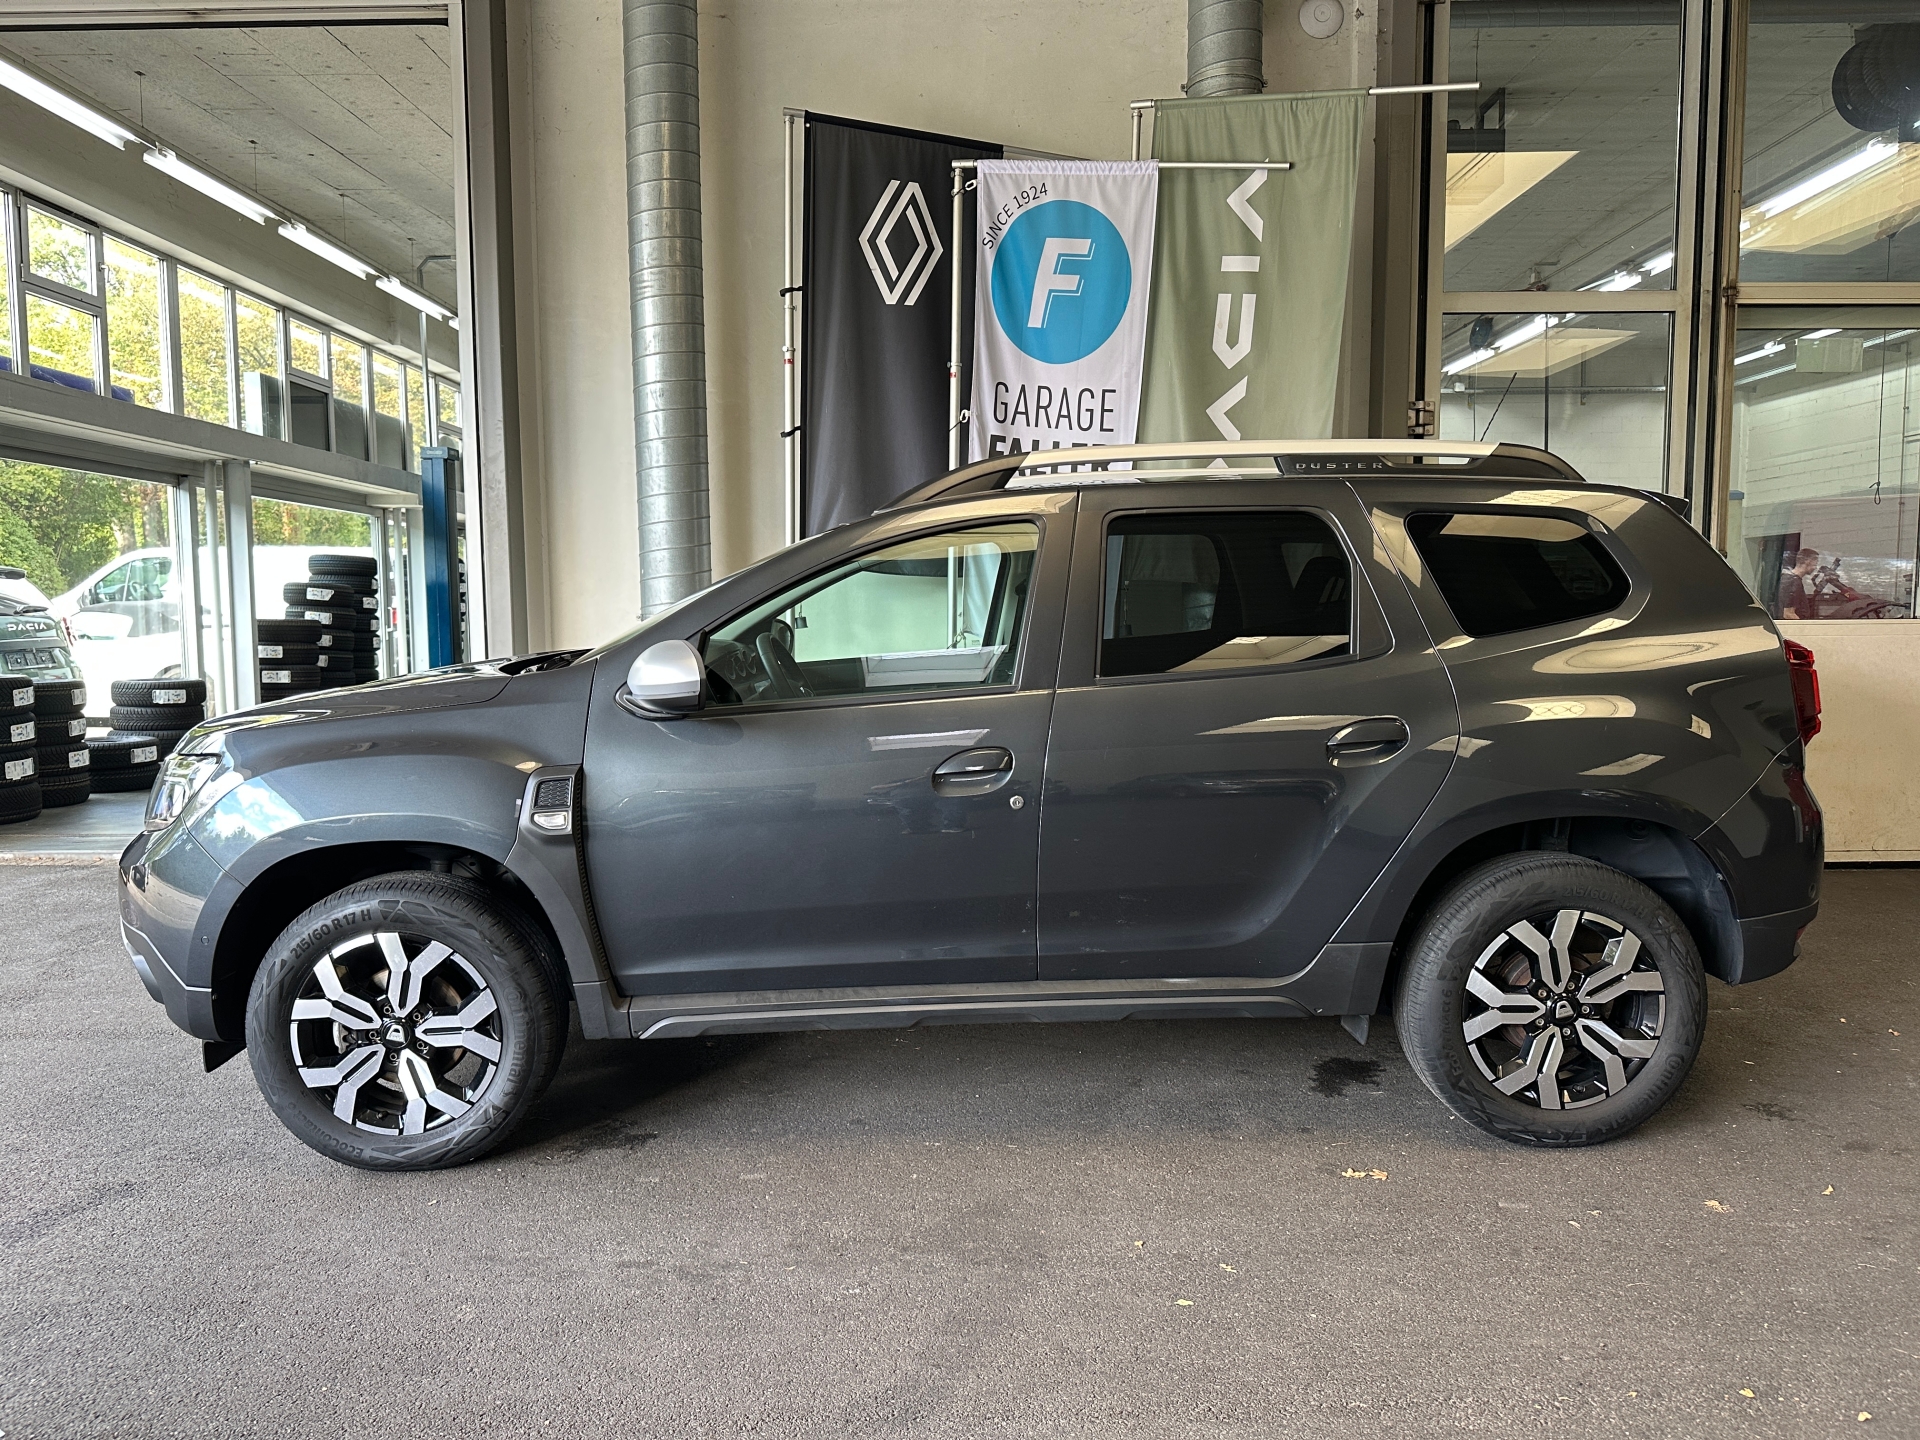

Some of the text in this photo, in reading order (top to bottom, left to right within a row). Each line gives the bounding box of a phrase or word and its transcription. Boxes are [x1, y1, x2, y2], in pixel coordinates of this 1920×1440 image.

[982, 182, 1048, 249] SINCE 1924
[1206, 158, 1269, 469] ACIA
[993, 382, 1117, 432] GARAGE
[6, 622, 47, 632] DACIA
[290, 923, 331, 959] 215/60
[361, 908, 372, 922] H
[503, 986, 528, 1085] Continental
